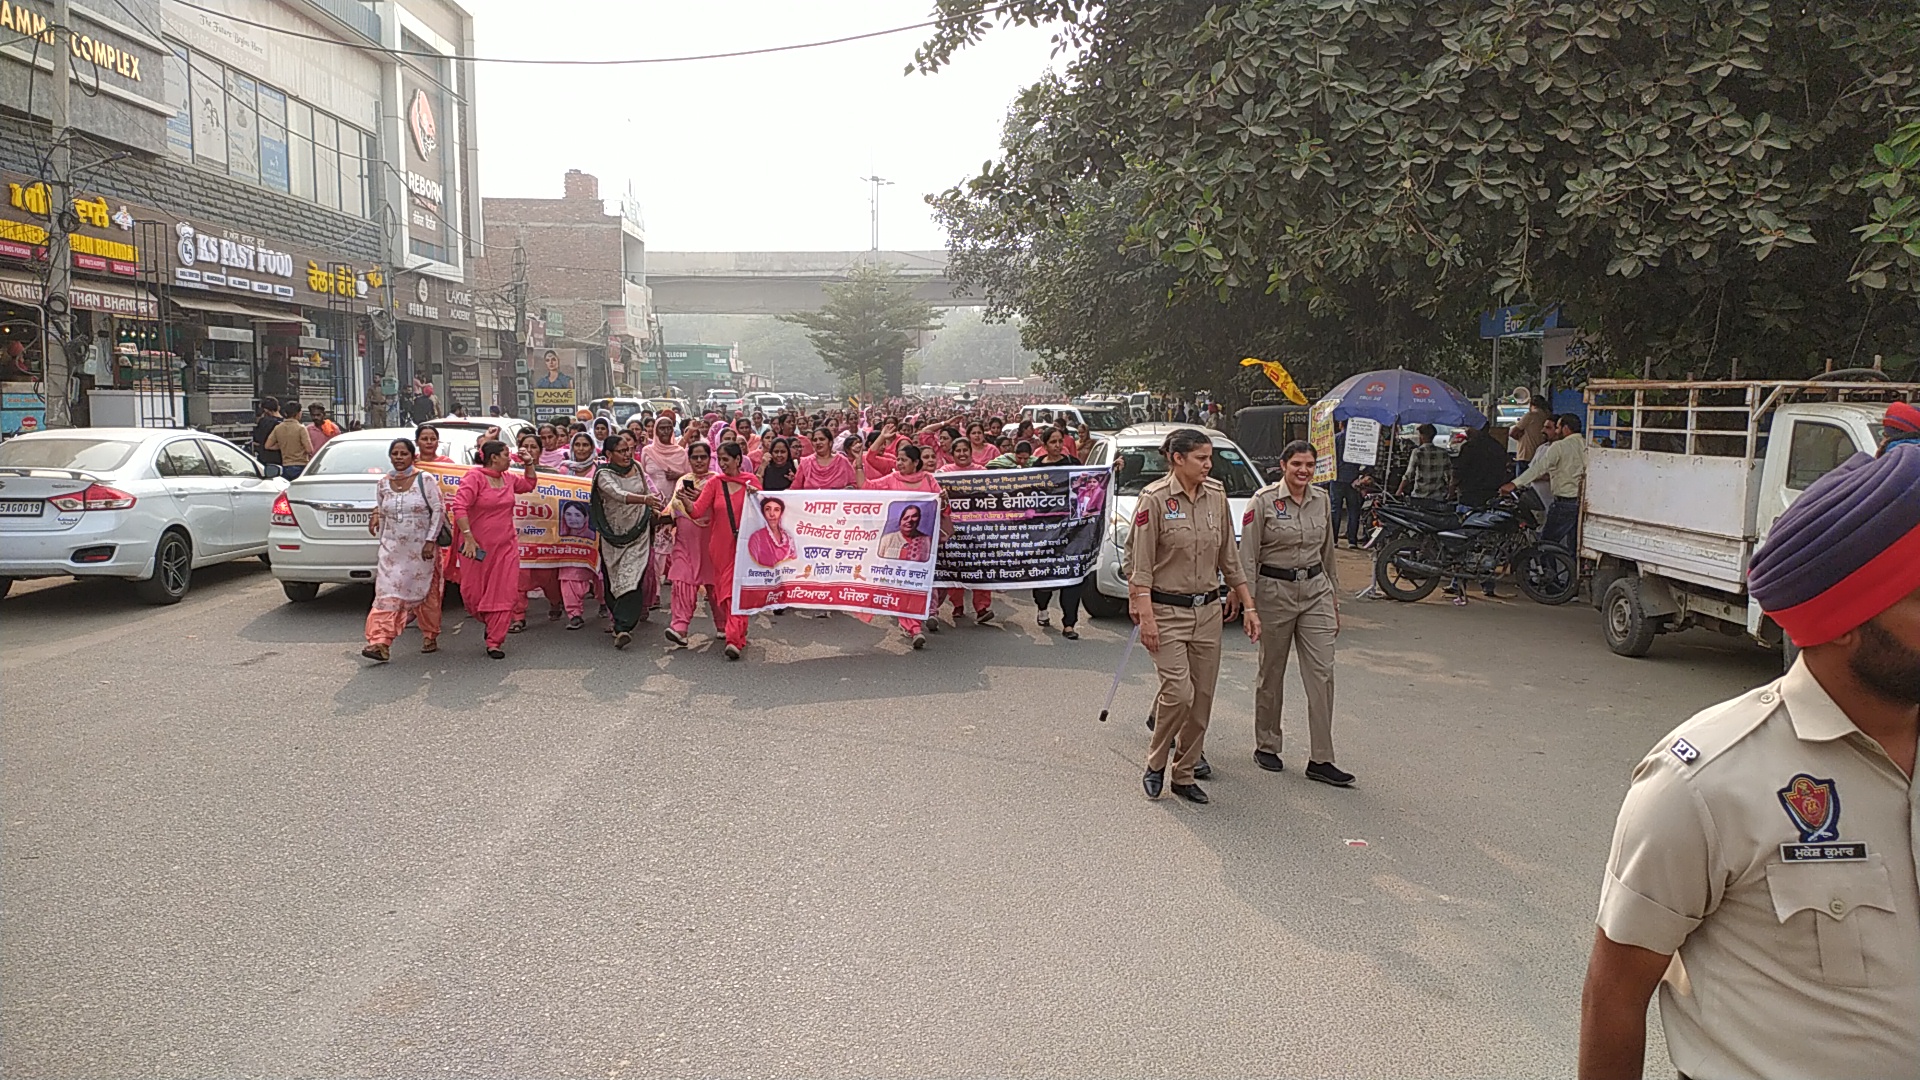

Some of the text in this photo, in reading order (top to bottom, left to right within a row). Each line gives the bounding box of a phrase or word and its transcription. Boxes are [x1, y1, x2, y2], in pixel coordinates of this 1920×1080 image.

[199, 14, 212, 28] The
[70, 31, 141, 81] COMPLEX
[408, 170, 443, 205] REBORN
[98, 238, 139, 262] BHANDAR
[196, 234, 293, 278] KS FAST FOOD
[104, 296, 153, 313] BHANDAR
[450, 308, 471, 321] ACADEMY
[443, 475, 460, 485] ਵਰਕ
[575, 490, 591, 500] ਪੰਜਾ
[804, 501, 883, 515] ਆਸ਼ਾ ਵਰਕਰ
[949, 491, 1066, 510] ਕਰ ਅਤੇ ਫੈਸੀਲੀਟੇਟਰ
[514, 500, 552, 519] ਰੁੱਪ)
[334, 514, 372, 523] PB10DD5
[524, 526, 546, 535] ਪੰਜੋਲਾ
[804, 547, 868, 560] ਬਲਾਕ ਭਾਦਸੋਂ
[835, 562, 853, 574] ਪੰਜਾਬ
[871, 565, 893, 576] ਜਸਵੀਰ
[896, 566, 907, 577] ਕੌਰ
[961, 569, 983, 579] ਜਲਦੀ
[986, 568, 996, 578] ਹੀ
[999, 568, 1025, 578] ਇਹਨਾਂ
[1028, 567, 1050, 576] ਦੀਆਂ
[1053, 565, 1070, 575] ਮੰਗਾਂ
[787, 587, 833, 602] ਪਟਿਆਲਾ,
[839, 588, 870, 602] ਪੰਜੋਲਾ
[873, 593, 899, 607] ਗਰੁੱਪ
[1672, 740, 1696, 761] PP
[1794, 846, 1854, 859] ਮੁਕੇਸ਼ ਕੁਮਾਰ
